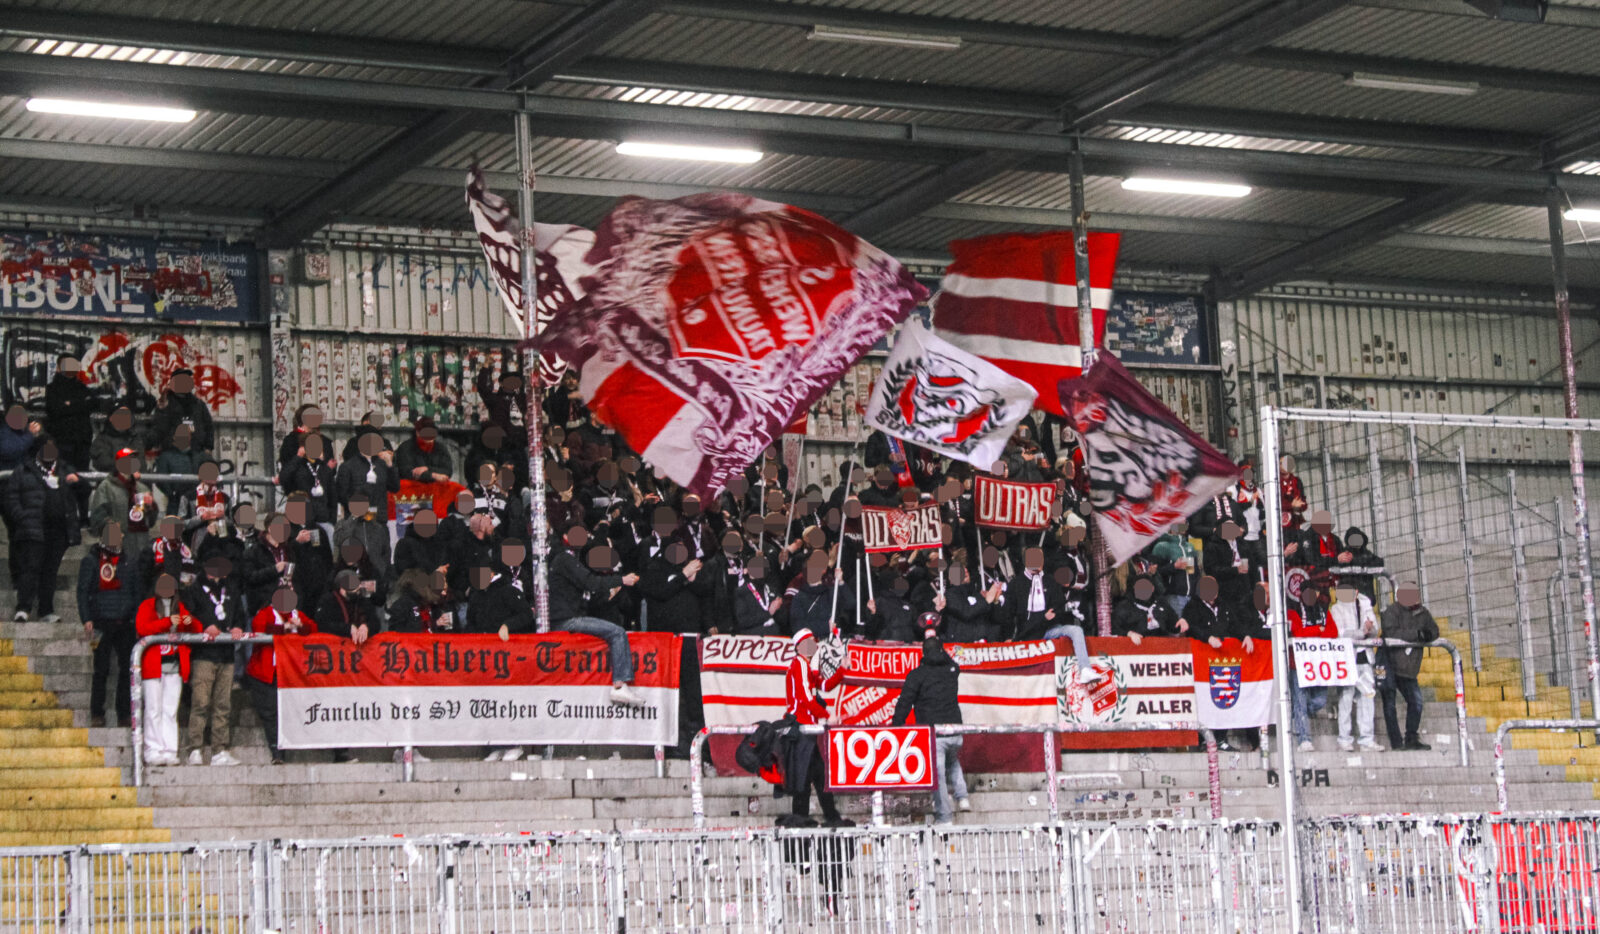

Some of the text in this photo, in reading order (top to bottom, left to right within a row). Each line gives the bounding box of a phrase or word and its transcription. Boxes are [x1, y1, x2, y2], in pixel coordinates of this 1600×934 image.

[980, 480, 1052, 525] ULTRAS
[303, 640, 363, 676] Die
[963, 640, 1056, 664] RHEINGAU
[1295, 642, 1345, 652] Mocke
[1129, 662, 1193, 677] WEHEN
[1303, 661, 1348, 681] 305
[304, 699, 658, 726] Fanclub des SV Wehen Taunusstein
[1136, 700, 1192, 715] ALLER
[833, 730, 926, 784] 1926
[1267, 769, 1331, 788] DPA
